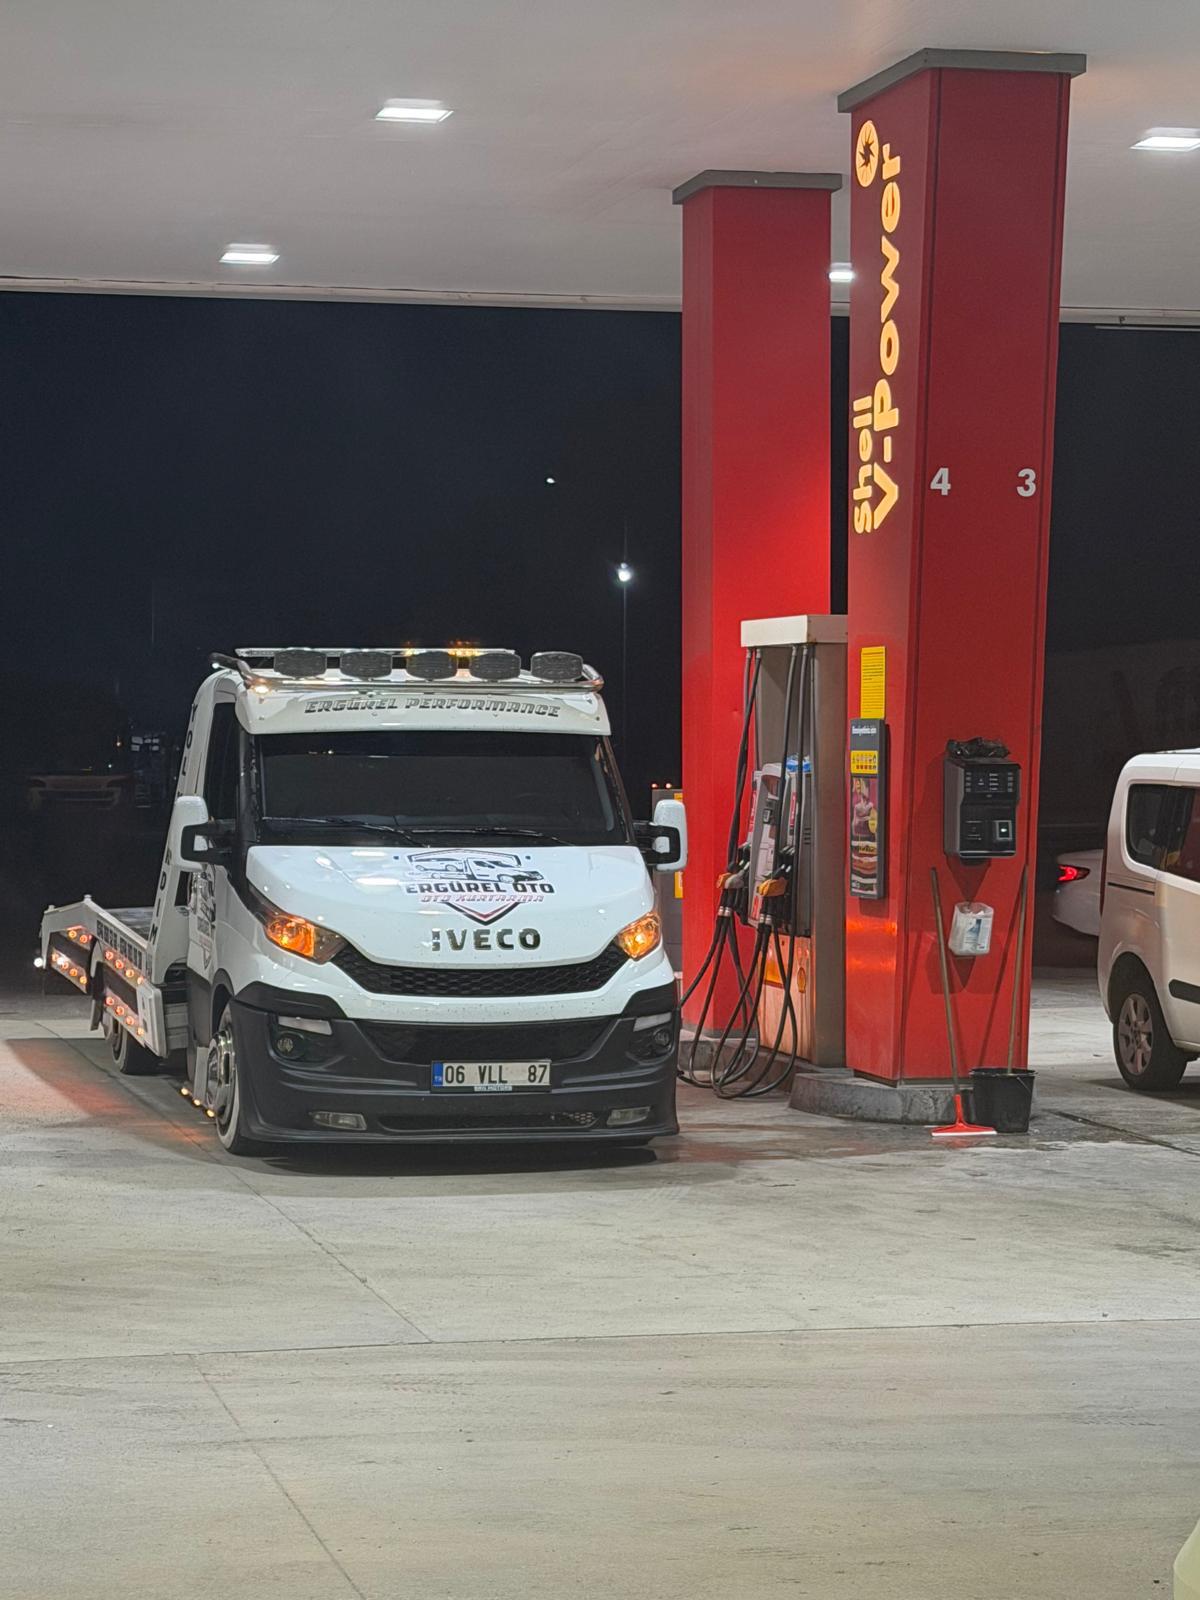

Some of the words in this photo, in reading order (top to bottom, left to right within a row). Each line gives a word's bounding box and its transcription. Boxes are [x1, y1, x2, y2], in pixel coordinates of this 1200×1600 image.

[873, 143, 901, 529] V-Power
[852, 395, 873, 534] Shell
[929, 467, 952, 496] 4
[1015, 468, 1037, 497] 3
[405, 697, 561, 717] PERFORMANCE
[182, 703, 199, 777] YOL
[406, 882, 507, 894] ERGÜREL
[512, 883, 555, 894] OTO
[421, 894, 452, 903] OTO
[431, 927, 541, 952] IVECO
[444, 1065, 466, 1084] 06
[478, 1065, 508, 1083] VLL
[527, 1064, 548, 1083] 87
